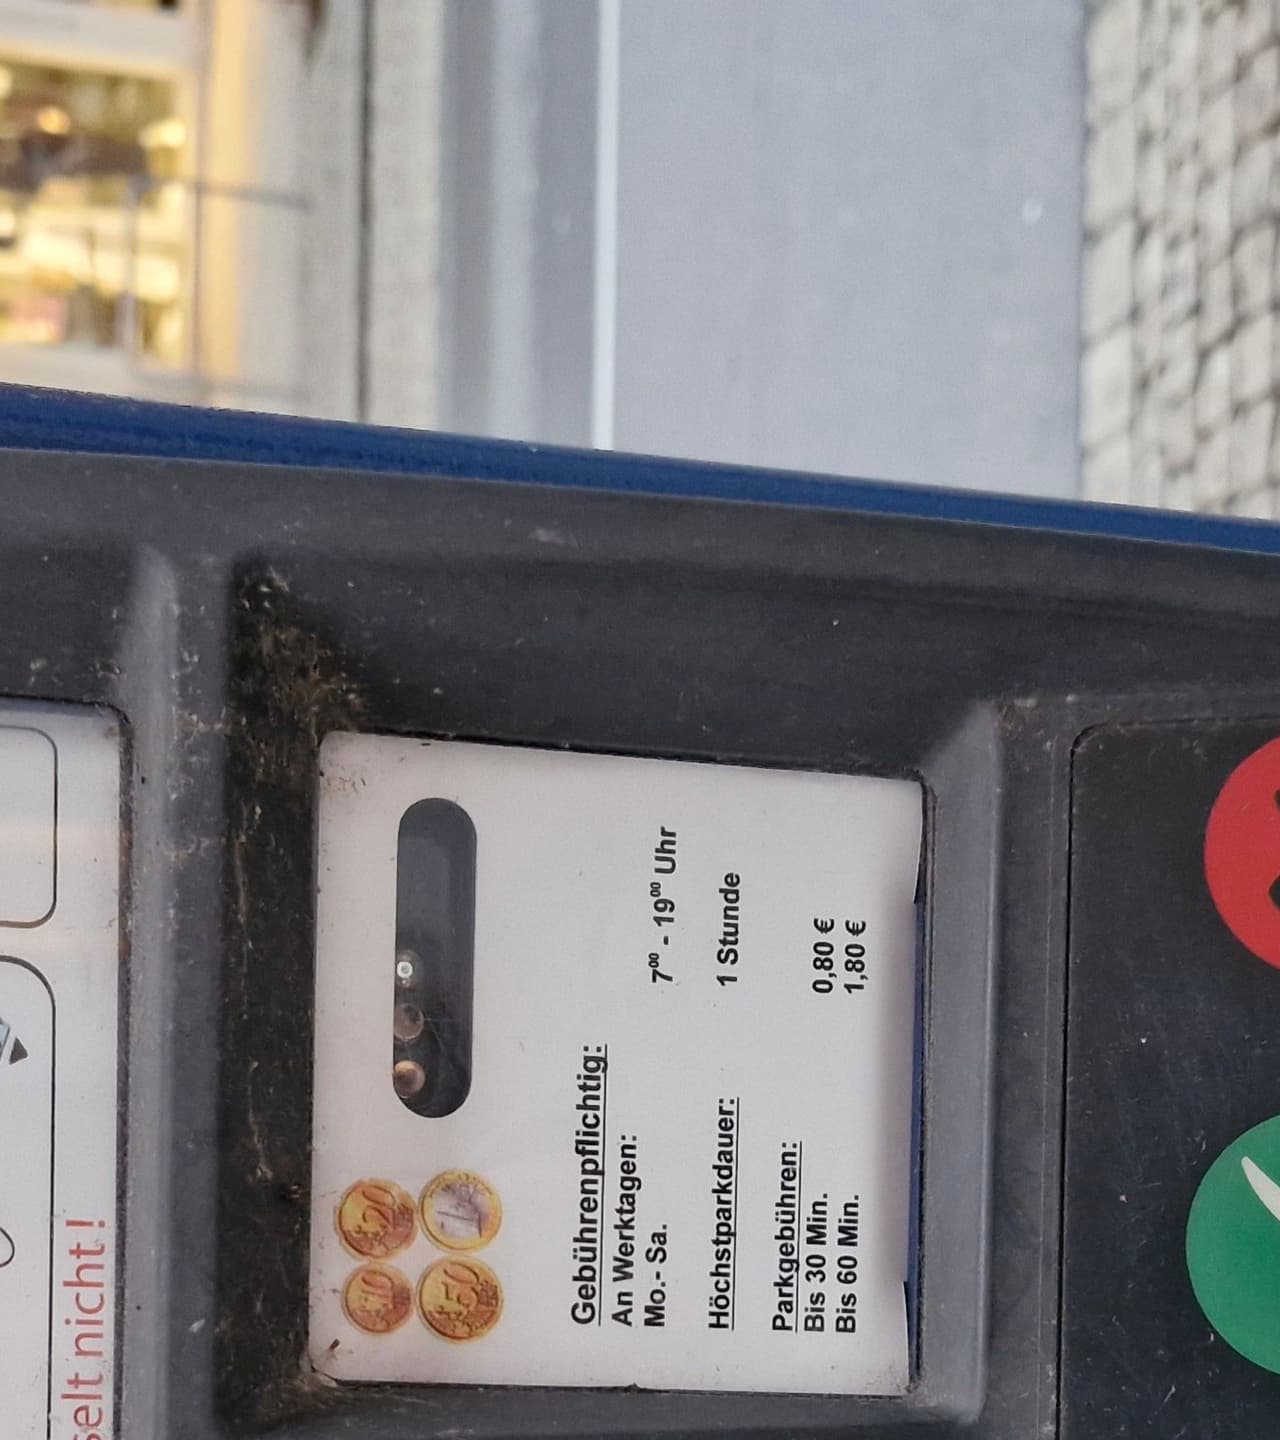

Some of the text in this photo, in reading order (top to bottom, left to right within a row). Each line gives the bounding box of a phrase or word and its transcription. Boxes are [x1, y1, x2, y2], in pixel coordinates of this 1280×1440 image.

[654, 826, 676, 874] Uhr
[717, 872, 741, 987] 1 Stunde
[811, 918, 837, 994] 0,80 €
[844, 920, 868, 995] 1,80 €
[571, 1044, 606, 1325] Gebührenpflichtig:
[612, 1134, 641, 1327] An Werktagen:
[645, 1224, 667, 1264] Sa.
[709, 1097, 739, 1330] Höchstparkdauer:
[772, 1141, 801, 1332] Parkgebühren:
[63, 1245, 106, 1359] nicht
[804, 1193, 829, 1333] Bis 30 Min.
[836, 1194, 860, 1334] Bis 60 Min.
